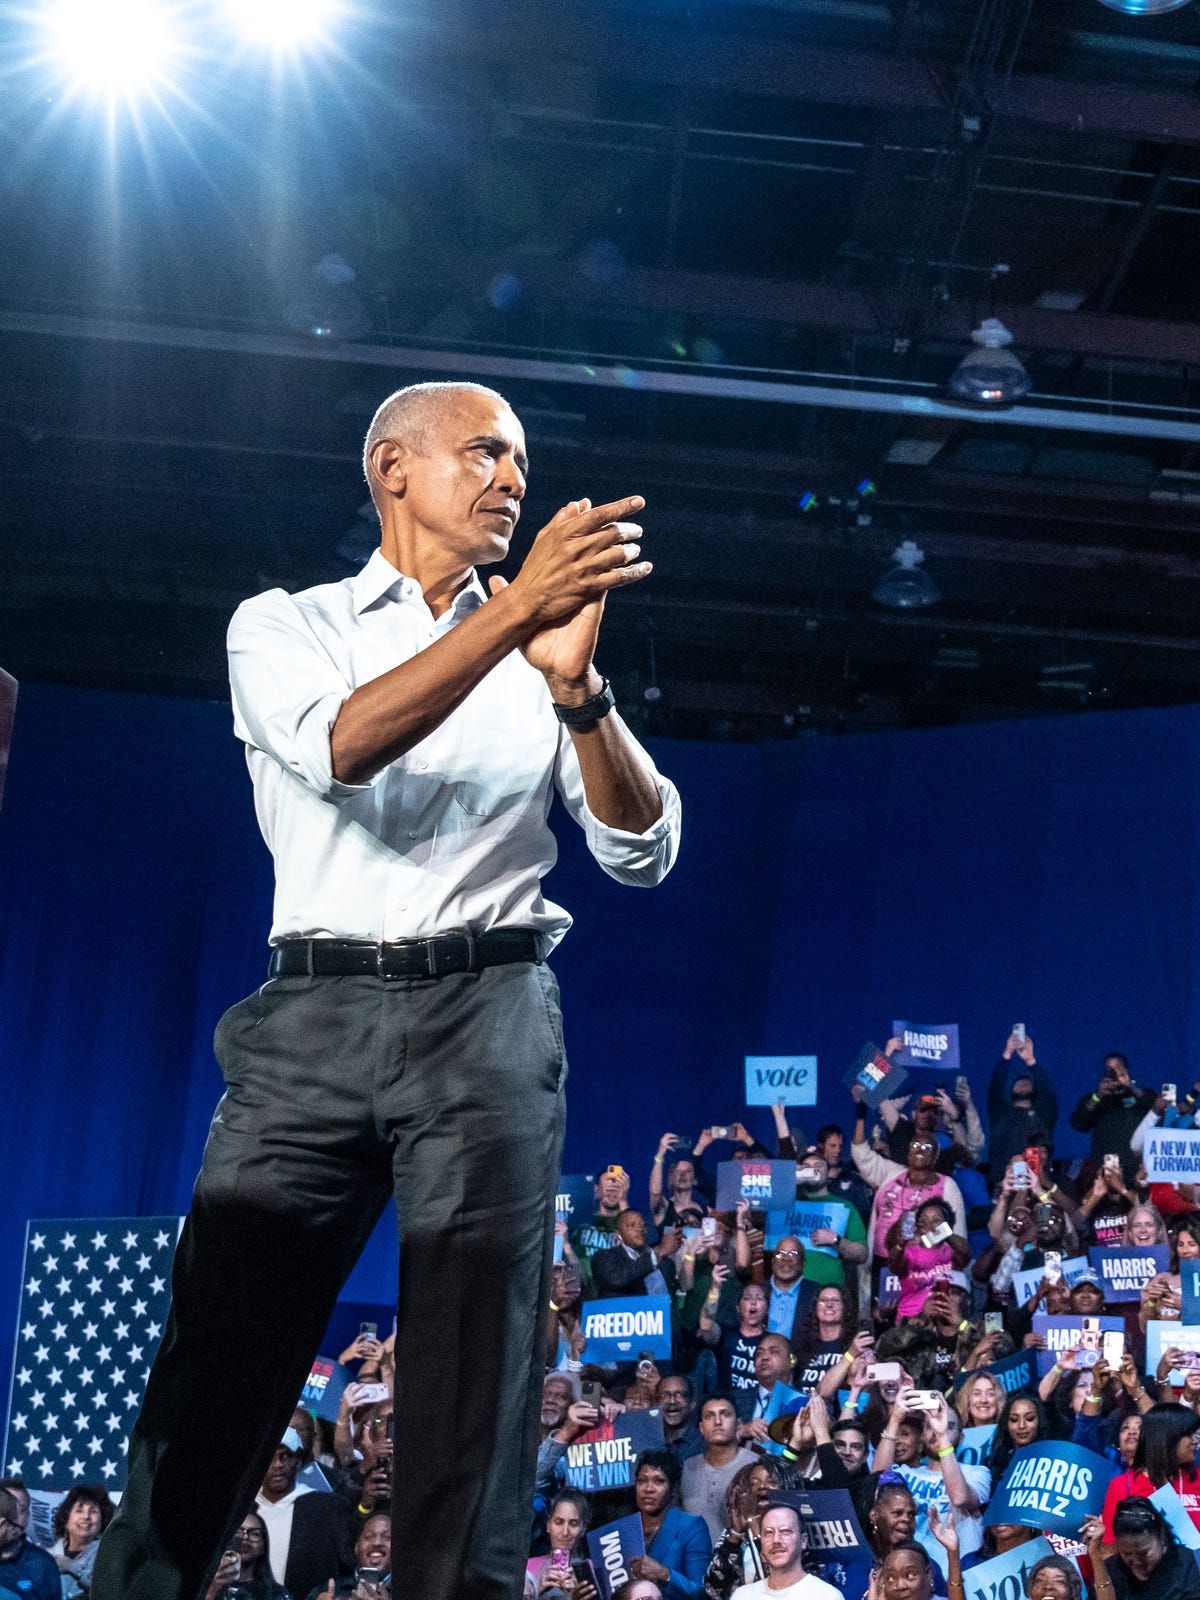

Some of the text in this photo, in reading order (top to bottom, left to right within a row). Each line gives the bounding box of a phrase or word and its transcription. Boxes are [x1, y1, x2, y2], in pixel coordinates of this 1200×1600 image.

[904, 1030, 948, 1051] HARRIS
[911, 1047, 942, 1060] WALZ
[755, 1065, 809, 1088] vote
[1150, 1140, 1157, 1156] A
[1161, 1141, 1186, 1156] NEW
[741, 1175, 772, 1186] SHE
[740, 1186, 772, 1198] CAN
[784, 1211, 833, 1229] HARRIS
[1102, 1257, 1157, 1279] HARRIS
[585, 1310, 664, 1338] FREEDOM
[730, 1355, 746, 1371] TO
[802, 1369, 818, 1382] TO
[567, 1437, 637, 1469] WE VOTE,
[568, 1462, 630, 1489] WE WIN
[1006, 1457, 1093, 1501] HARRIS
[1008, 1489, 1071, 1518] WALZ
